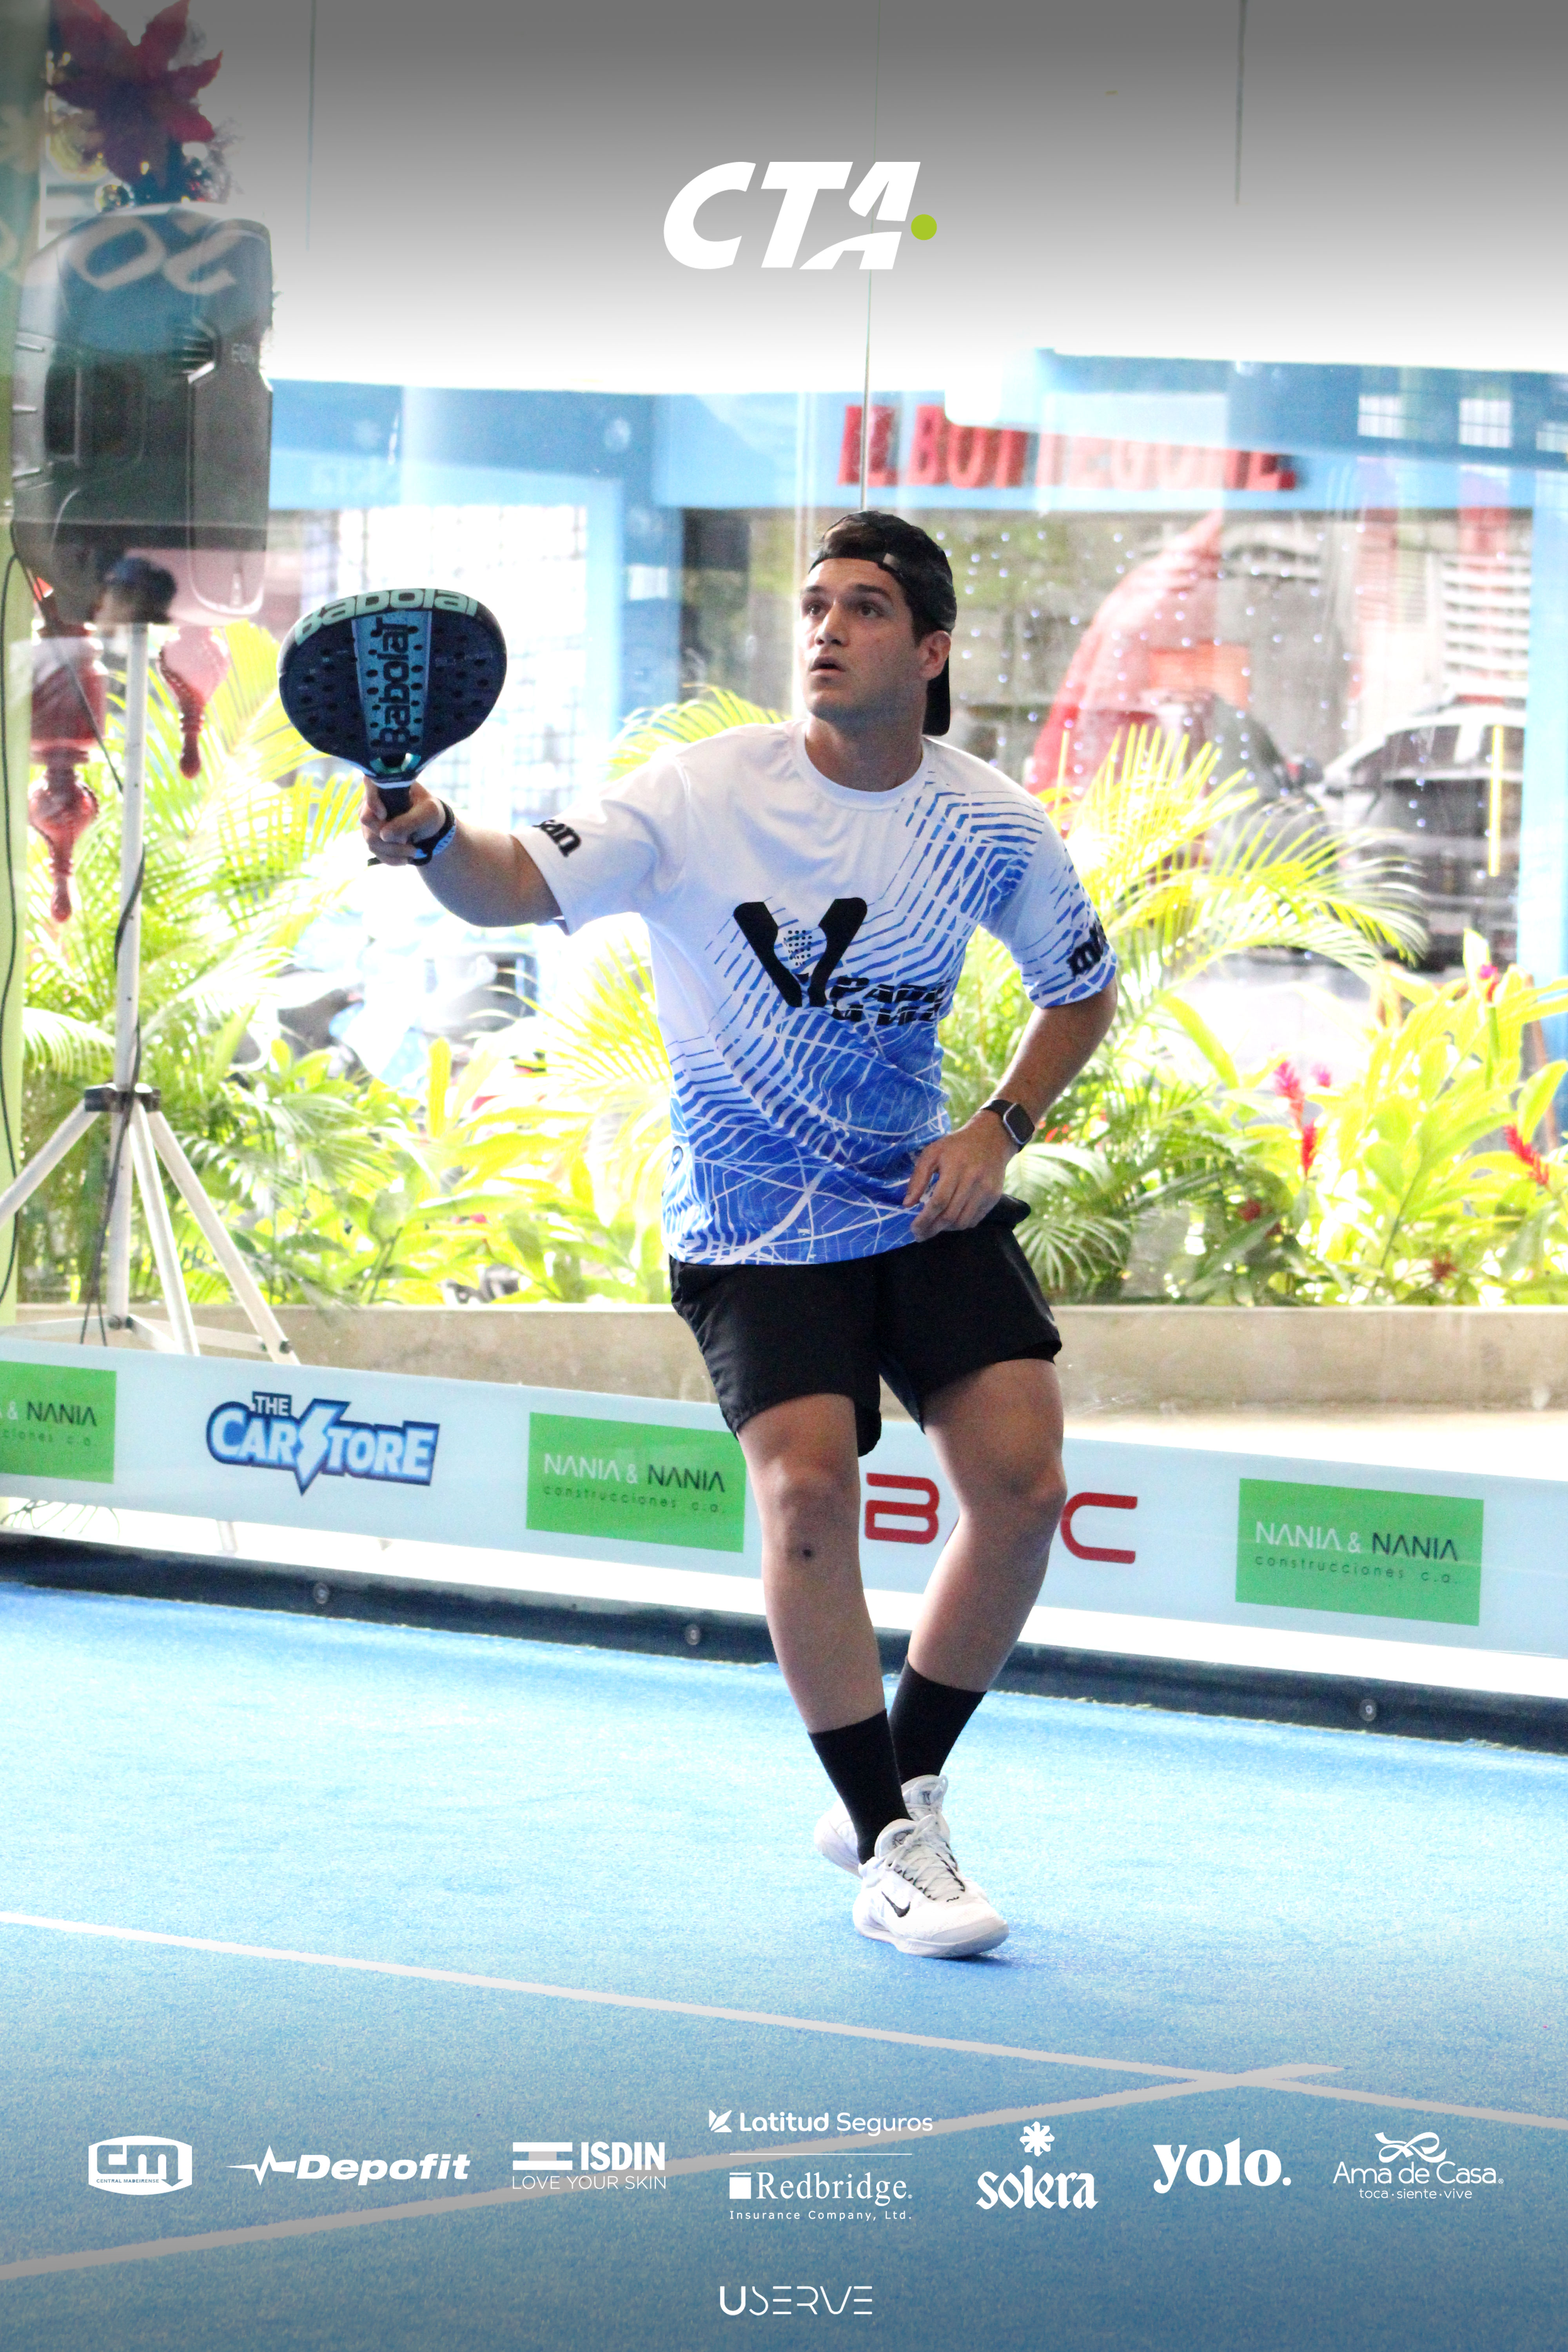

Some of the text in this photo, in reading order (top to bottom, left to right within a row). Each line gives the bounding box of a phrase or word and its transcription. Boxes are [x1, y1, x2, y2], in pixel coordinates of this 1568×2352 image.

[27, 1401, 97, 1427] NANIA
[254, 1394, 290, 1417] THE
[544, 1453, 725, 1492] NANIA & NANIA
[544, 1486, 677, 1508] construcciones
[1256, 1521, 1458, 1562] NANIA & NANIA
[1255, 1556, 1403, 1579] construcciones
